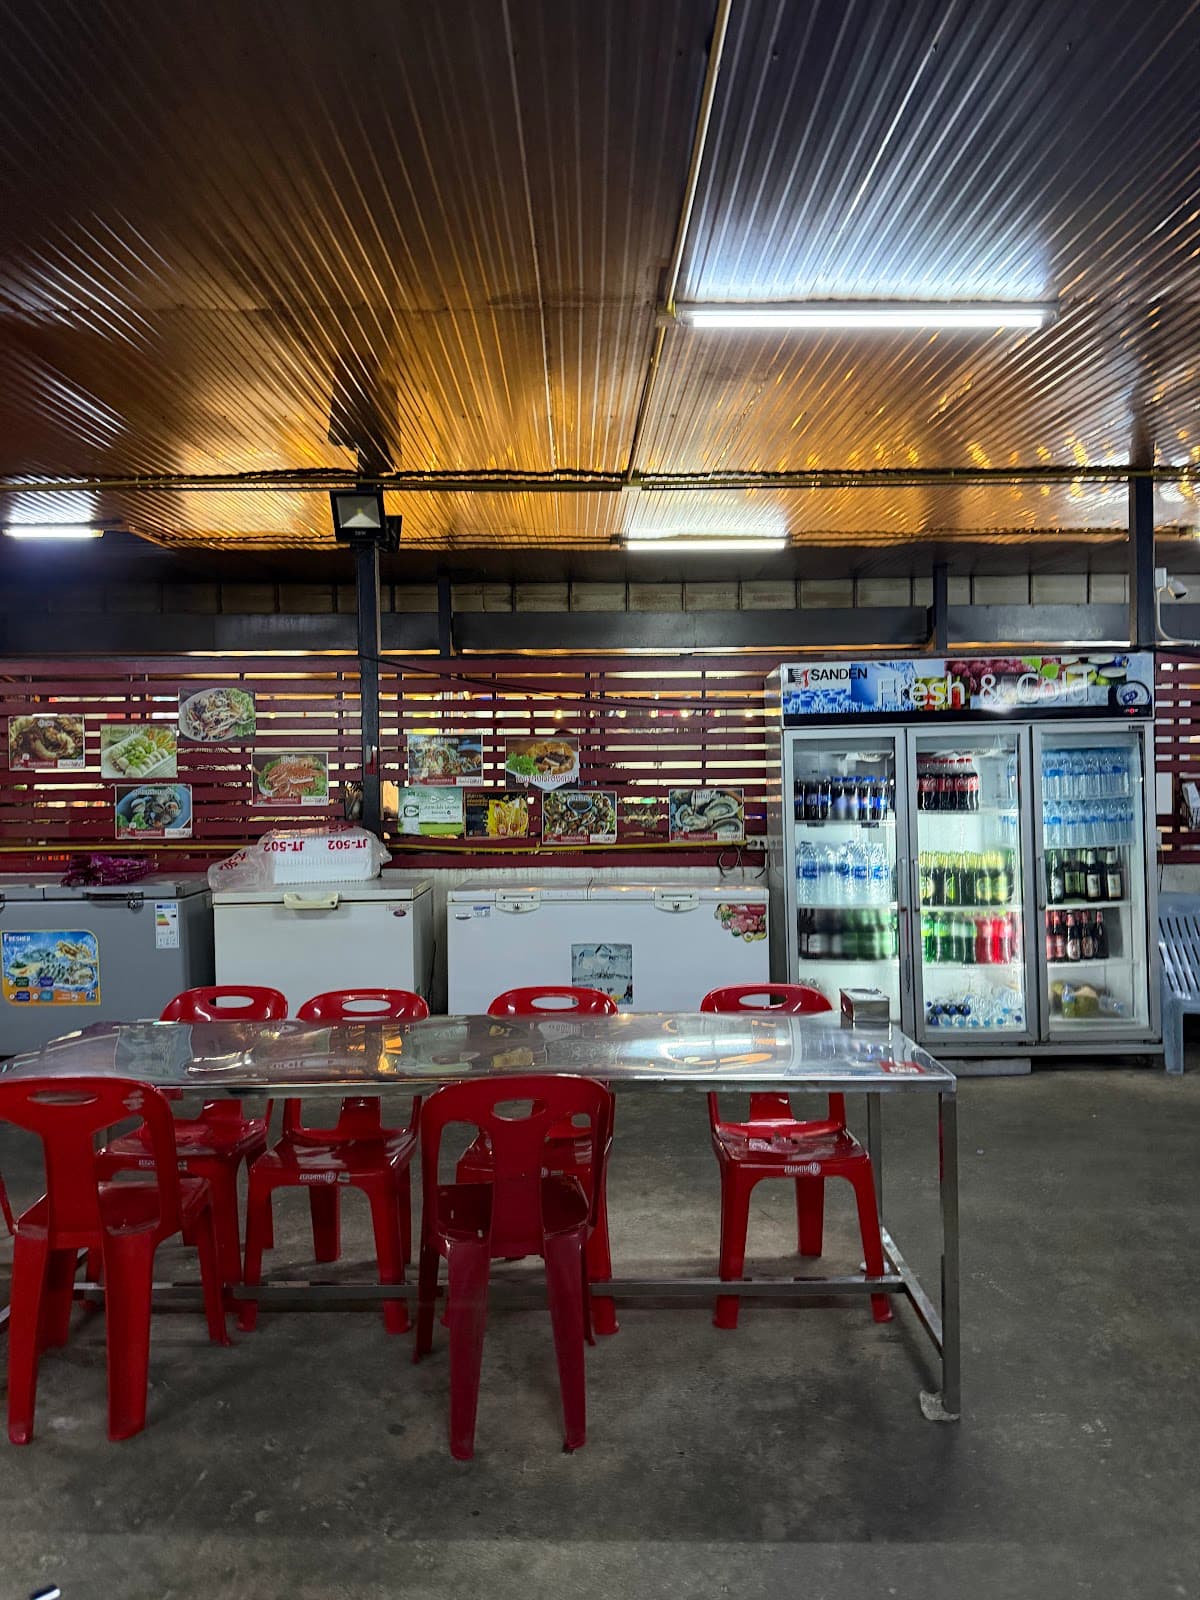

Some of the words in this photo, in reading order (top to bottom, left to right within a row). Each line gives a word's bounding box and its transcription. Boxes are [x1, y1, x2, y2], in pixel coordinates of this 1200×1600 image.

[810, 668, 868, 681] SANDEN
[877, 672, 965, 706] Fresh
[979, 673, 1001, 704] &
[1017, 671, 1089, 704] Cold
[263, 840, 305, 852] JT-502
[327, 838, 368, 850] JT-502
